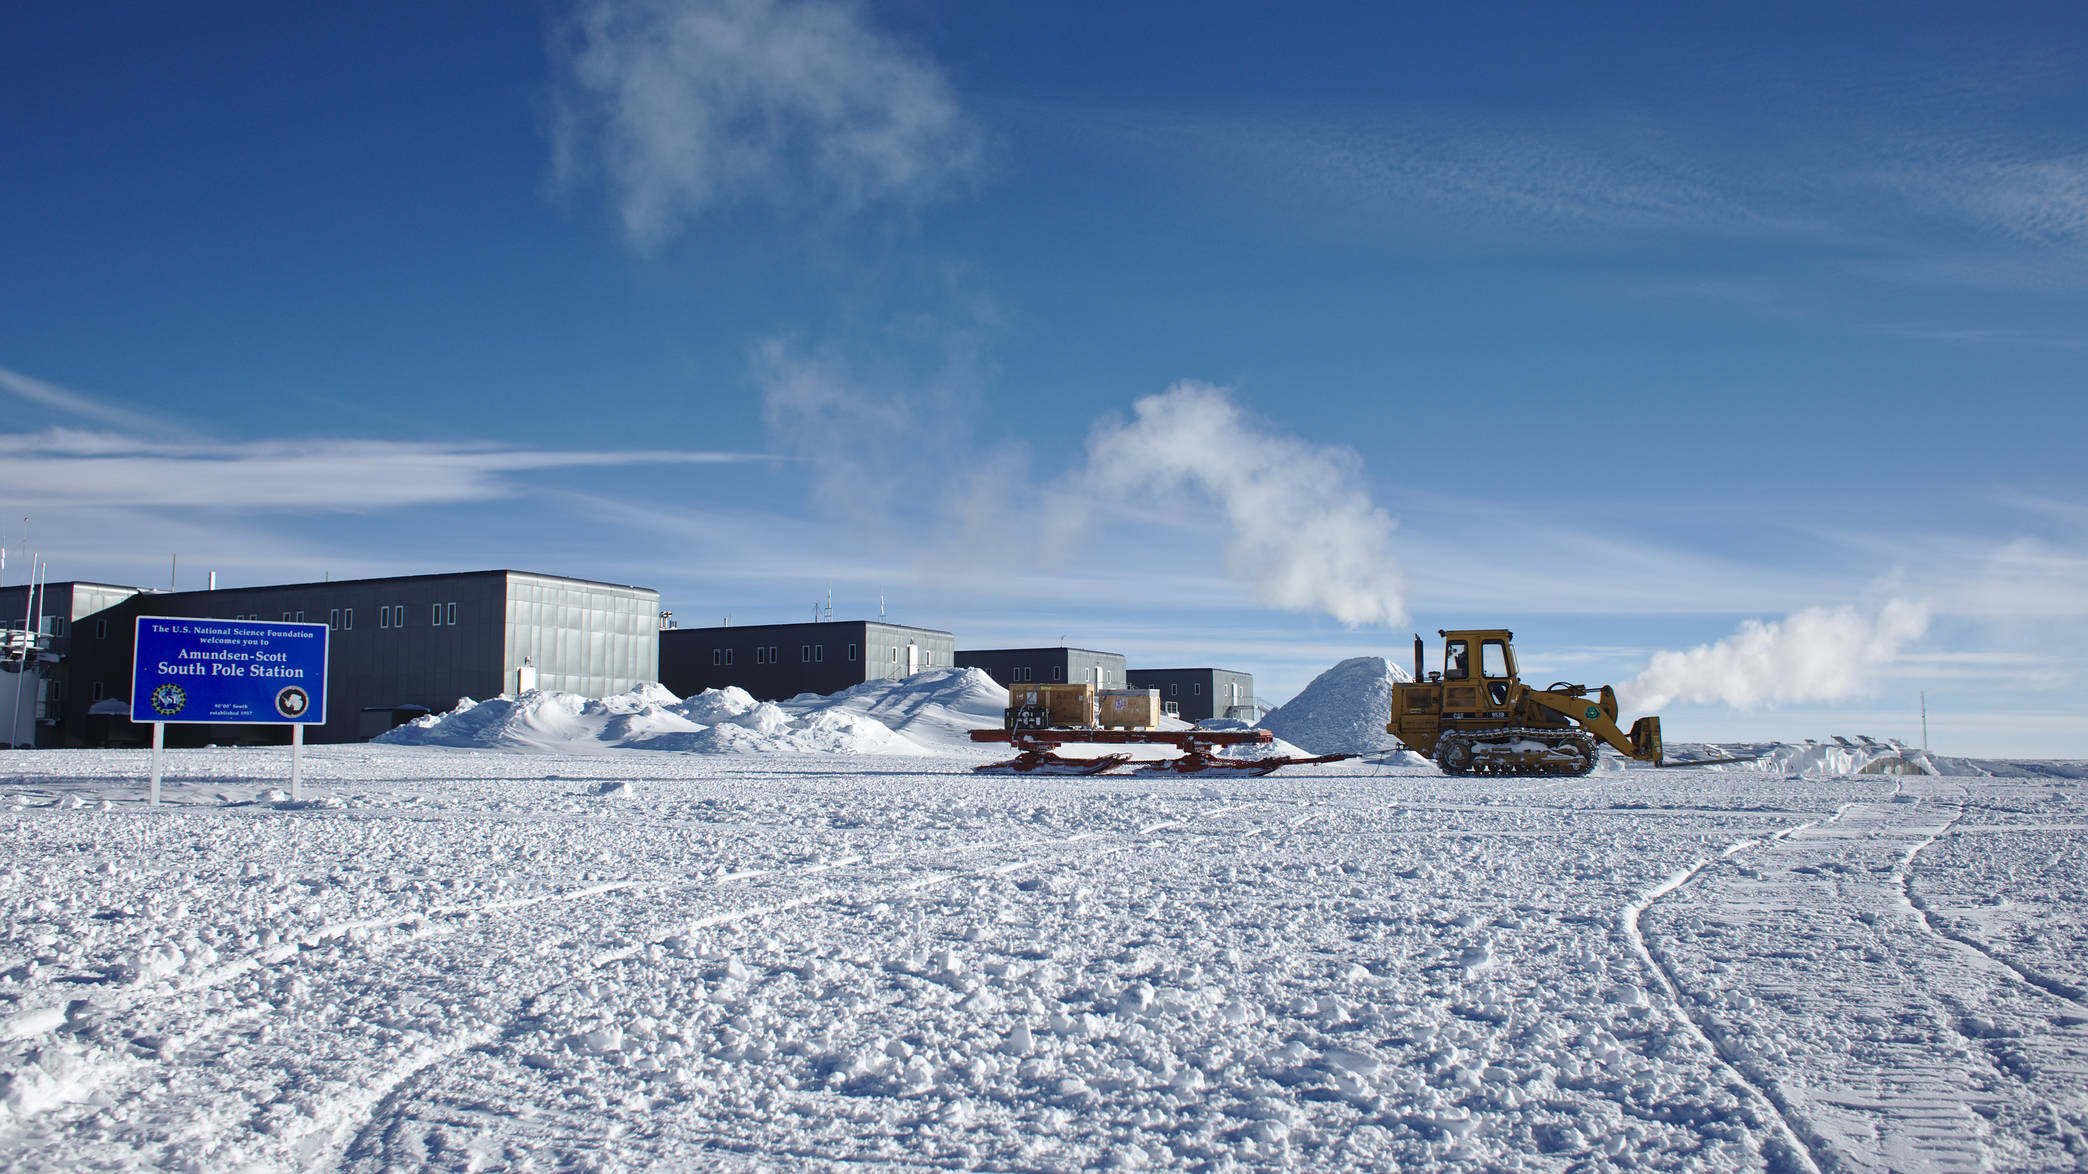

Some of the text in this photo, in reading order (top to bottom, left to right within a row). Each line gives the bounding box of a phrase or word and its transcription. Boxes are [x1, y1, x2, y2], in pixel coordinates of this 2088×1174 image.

[152, 625, 313, 639] The U.S. National Science Foundation
[199, 636, 241, 645] welcomes
[243, 638, 258, 647] you
[178, 648, 288, 662] Amundsen-Scott
[158, 661, 304, 678] South Pole Station
